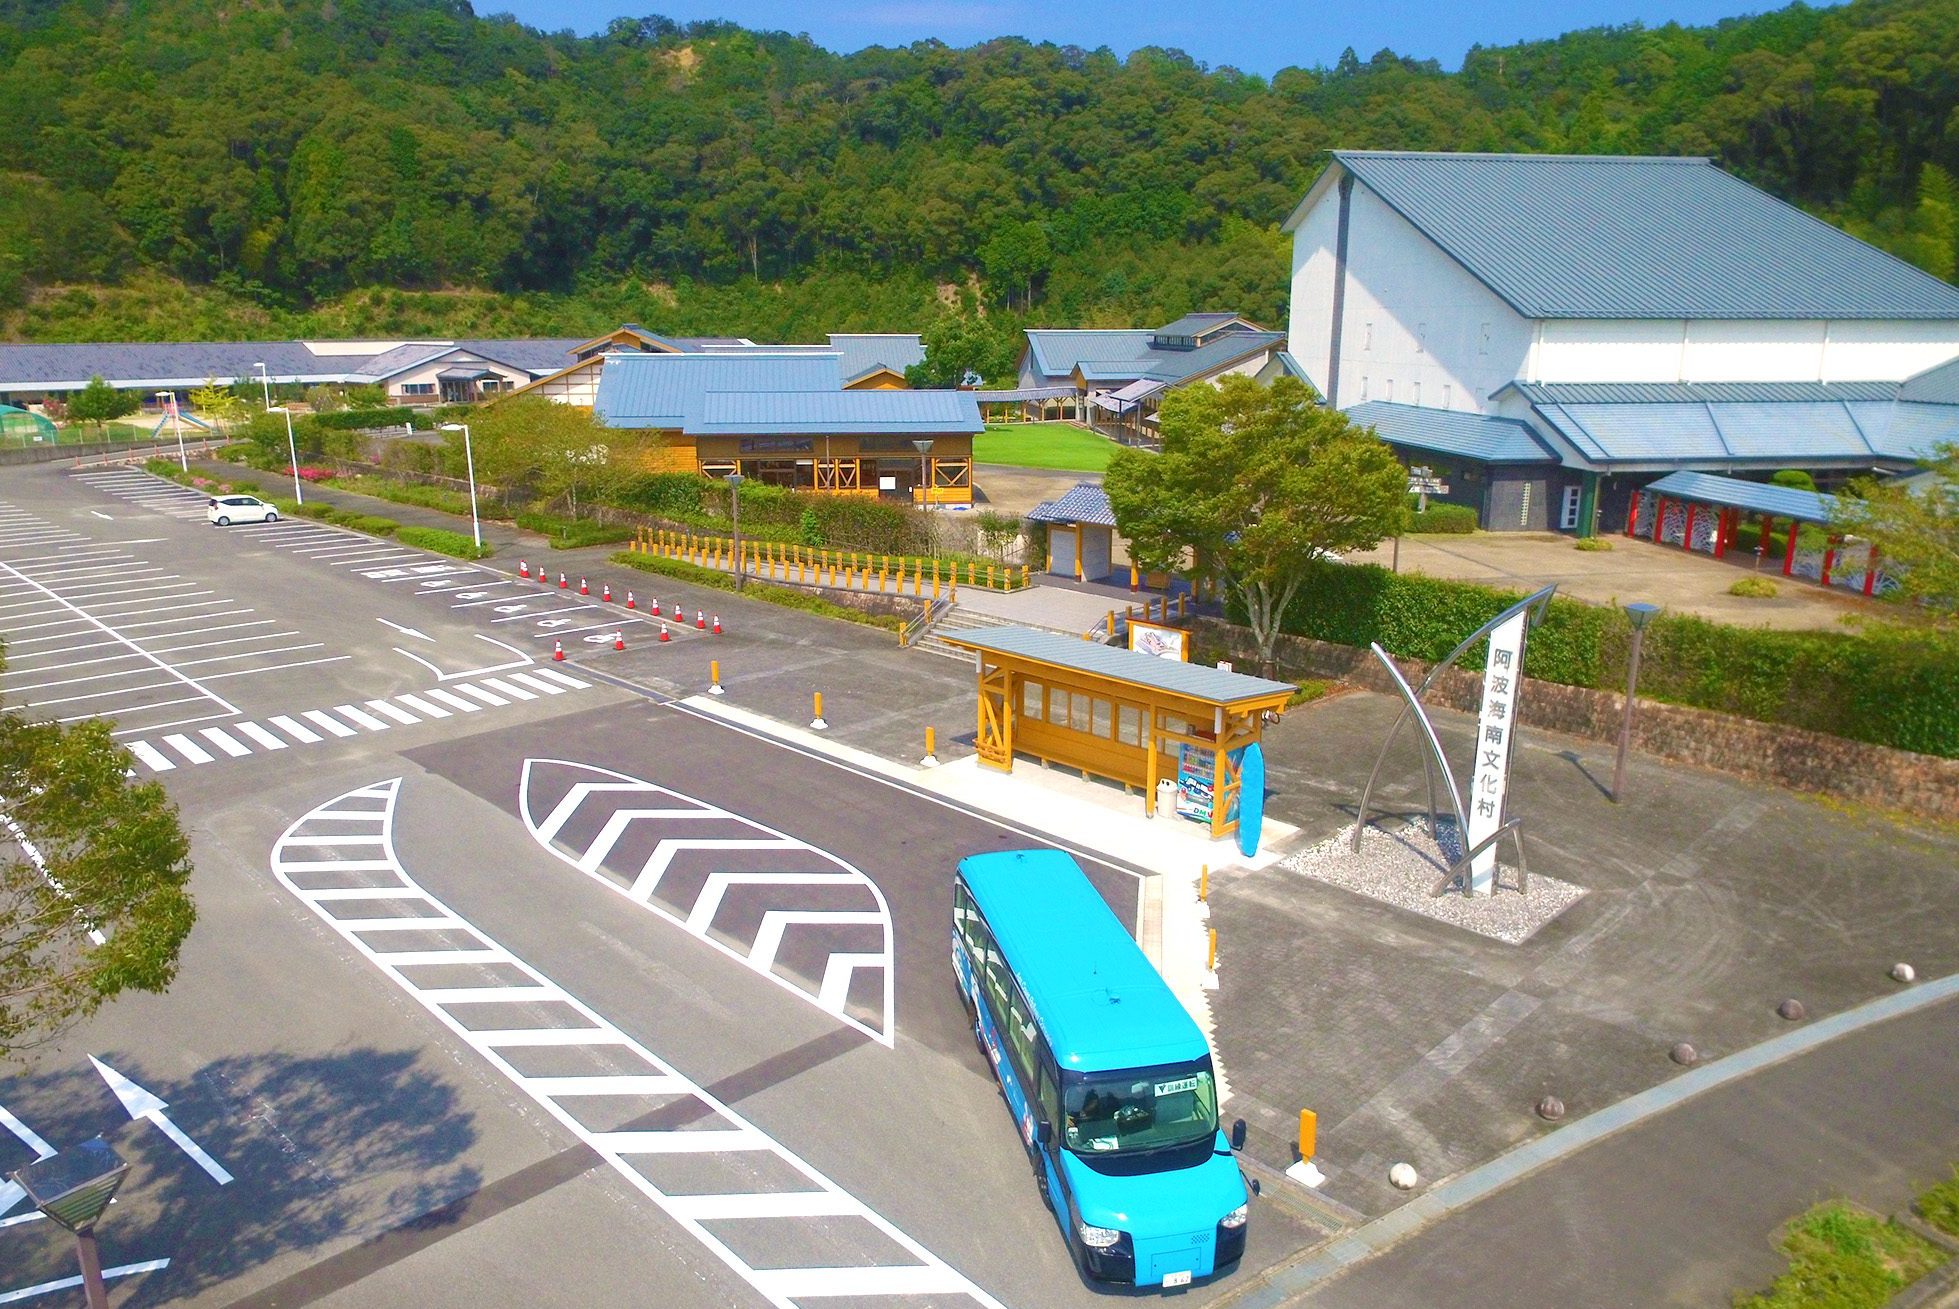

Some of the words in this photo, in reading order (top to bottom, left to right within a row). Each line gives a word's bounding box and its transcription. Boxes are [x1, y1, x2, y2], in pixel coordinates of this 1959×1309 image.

[1477, 648, 1513, 818] 阿波海南文化村
